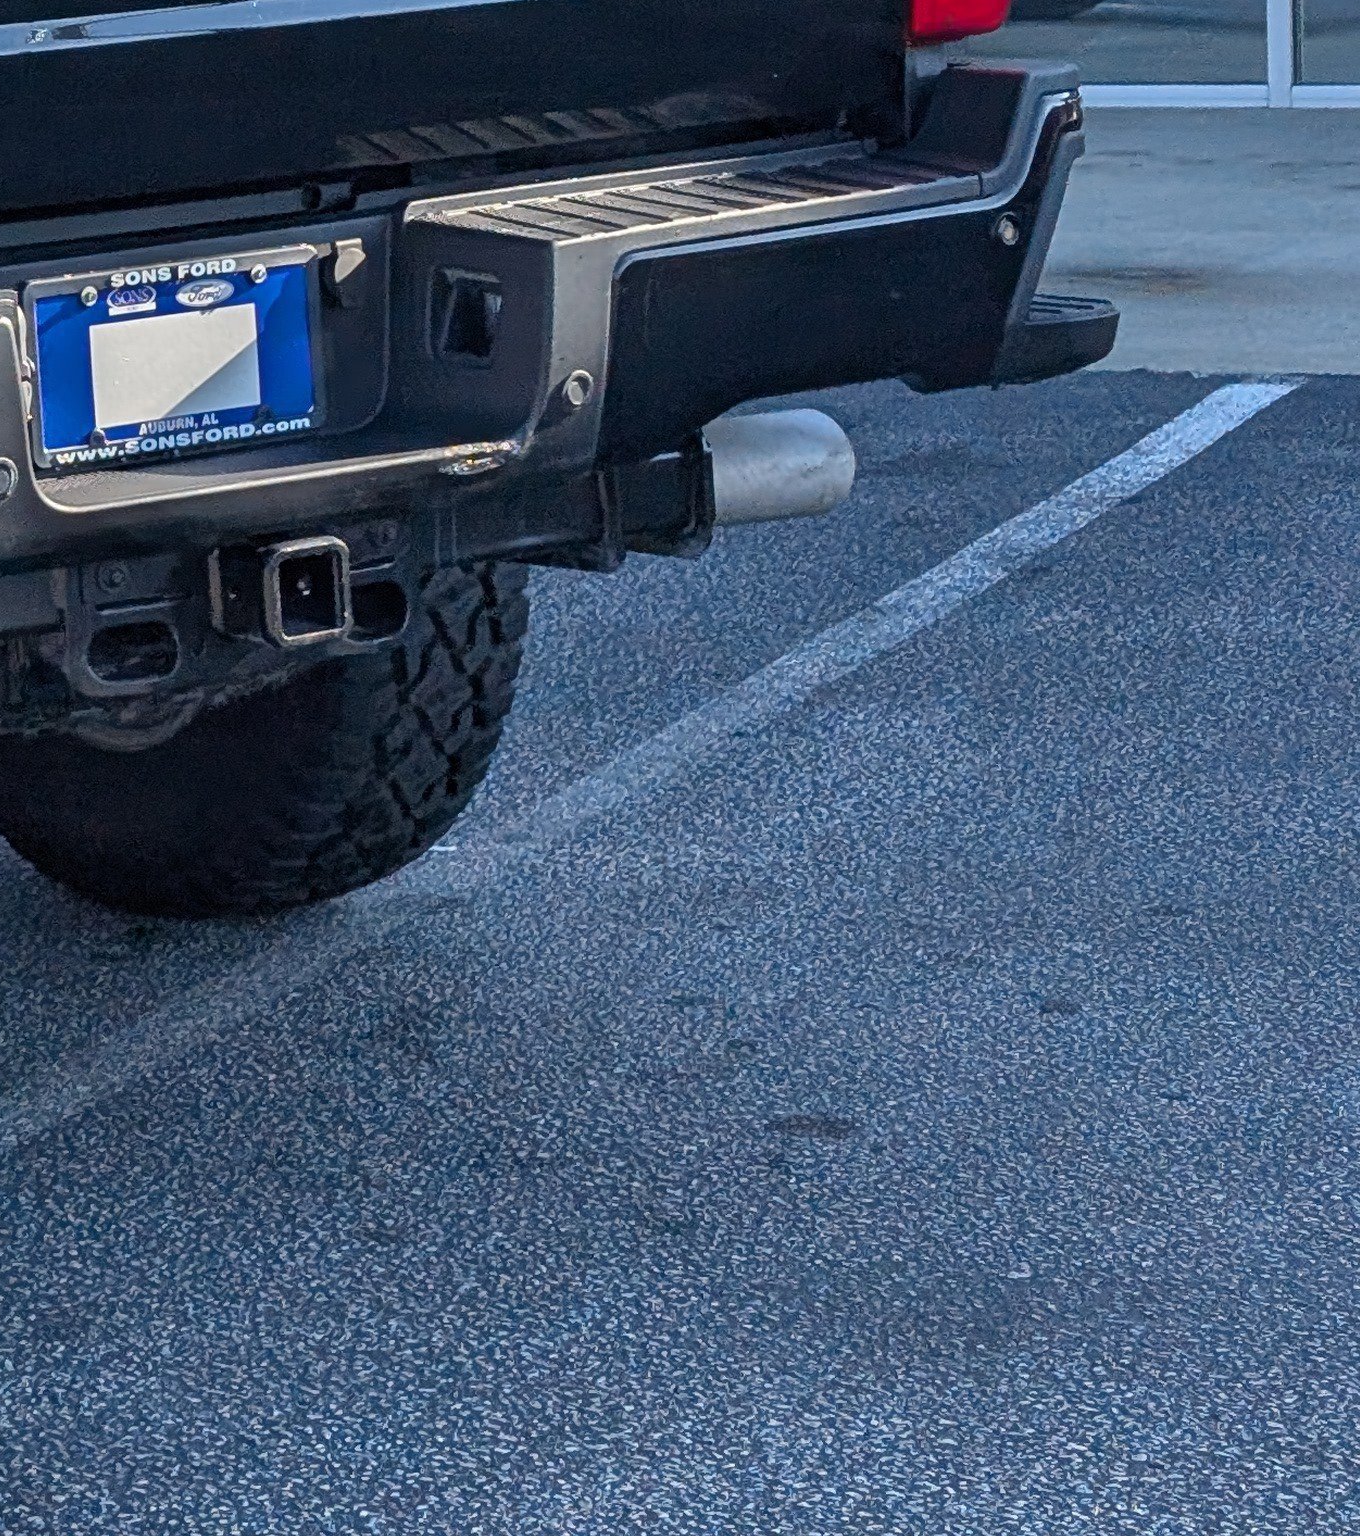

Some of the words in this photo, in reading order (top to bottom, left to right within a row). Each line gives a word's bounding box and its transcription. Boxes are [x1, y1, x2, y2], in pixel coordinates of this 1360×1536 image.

[110, 267, 172, 288] SONS
[177, 258, 237, 279] FORD
[138, 416, 199, 436] AUBURN,
[201, 413, 219, 425] AL
[56, 417, 311, 464] www.SONSFORD.com
